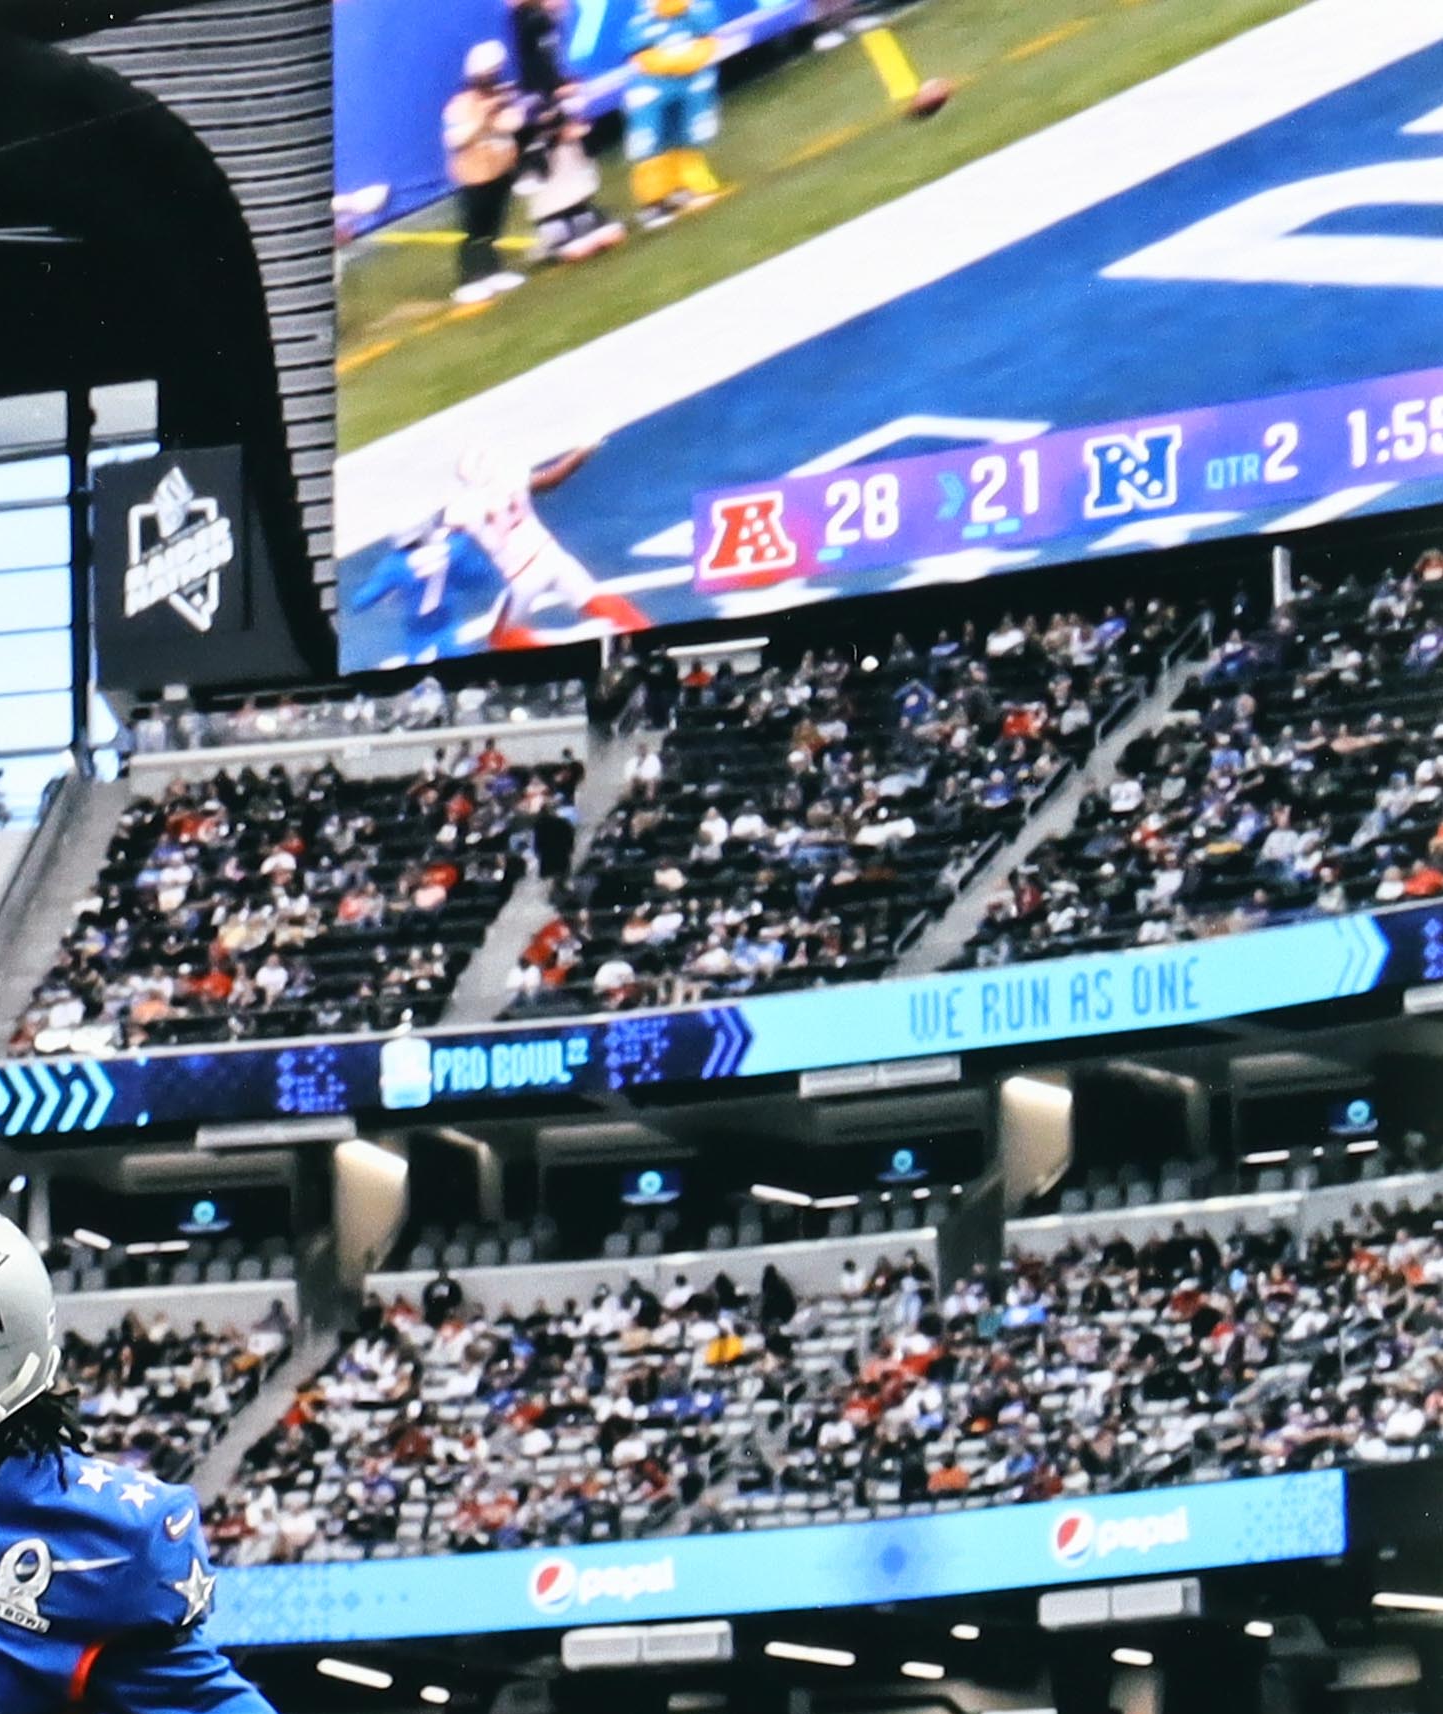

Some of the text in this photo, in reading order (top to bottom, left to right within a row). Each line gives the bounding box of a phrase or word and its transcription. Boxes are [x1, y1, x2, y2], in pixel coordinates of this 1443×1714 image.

[825, 473, 900, 546] 28
[970, 449, 1040, 524] 21
[1263, 421, 1299, 483] 2
[908, 956, 1201, 1041] WE RUN AS ONE
[433, 1046, 488, 1092] PRO
[491, 1039, 573, 1089] BOWL
[4, 1606, 49, 1632] BOWL
